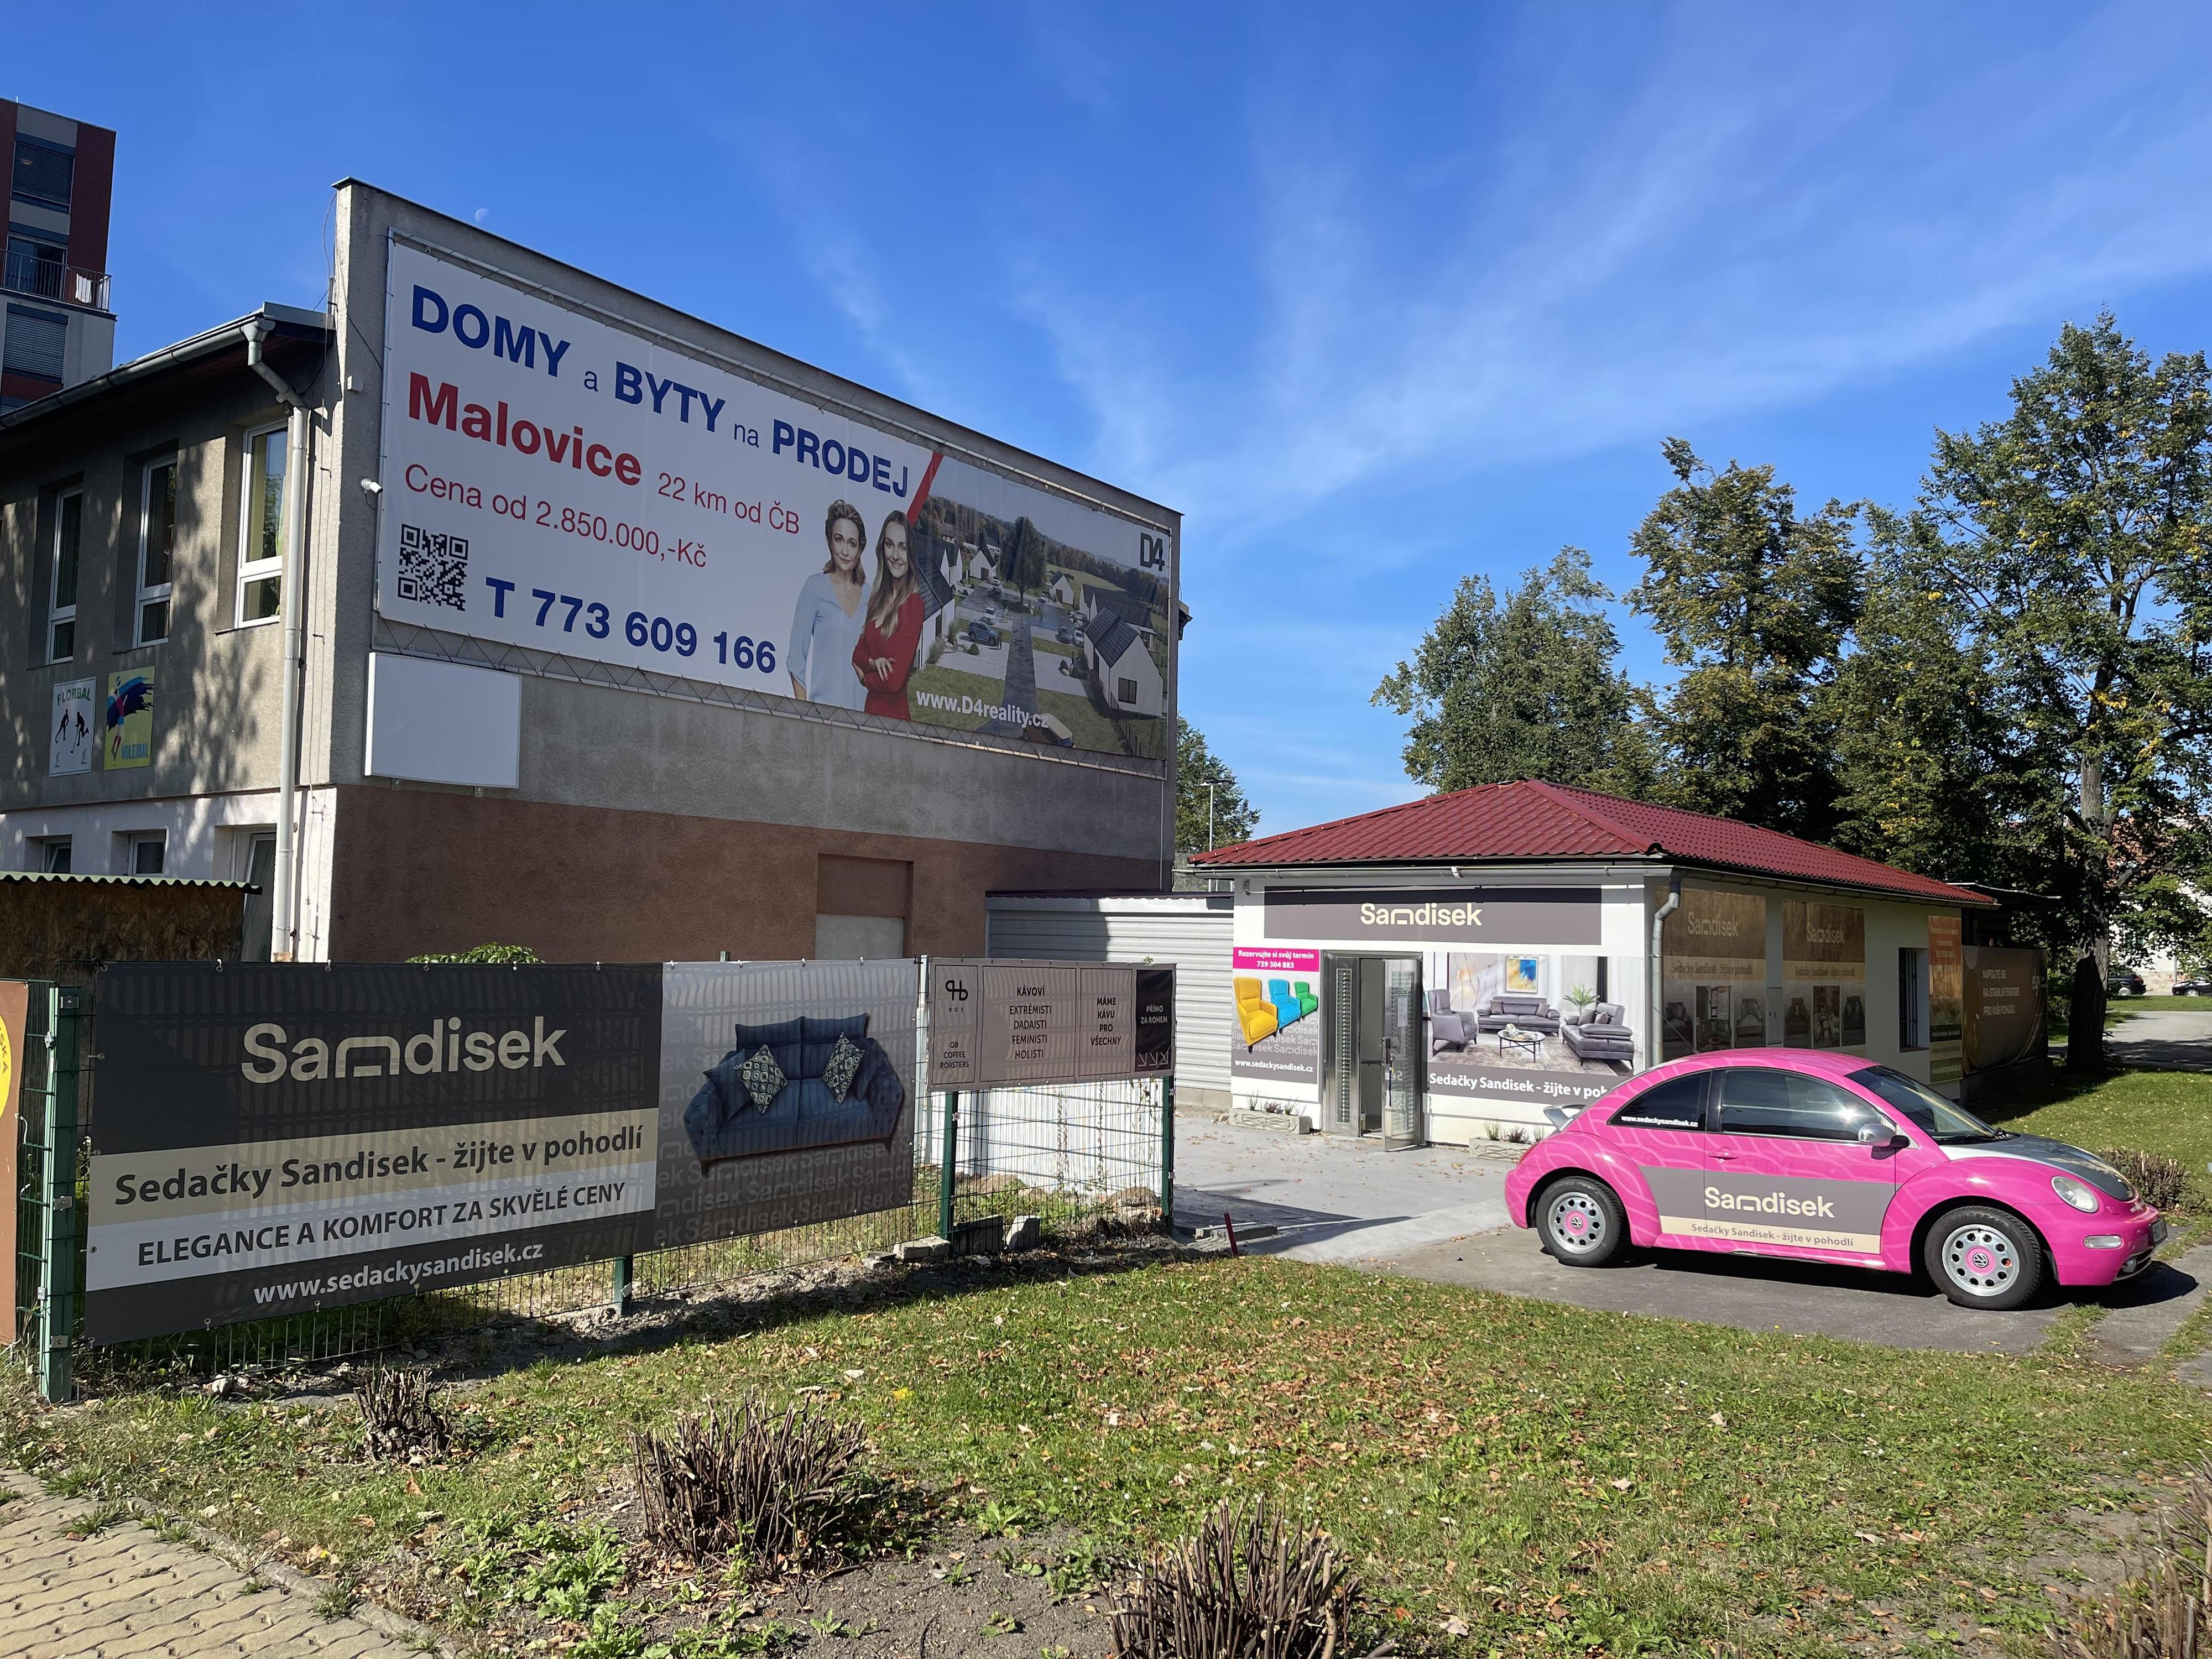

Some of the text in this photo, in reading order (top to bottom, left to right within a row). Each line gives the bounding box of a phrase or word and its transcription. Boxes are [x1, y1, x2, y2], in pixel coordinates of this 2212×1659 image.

[411, 284, 907, 497] DOMY a BYTY na PRODEJ
[408, 372, 799, 534] Malovice 22 km od ČB
[405, 464, 707, 567] Cena od 2.850.000,-Kč
[1139, 533, 1165, 572] D4
[485, 576, 775, 673] T 773 609 166
[58, 687, 90, 706] FLORBAL
[915, 690, 1048, 729] www.D4reality.cz
[122, 743, 148, 760] VOLEJBAL
[1360, 903, 1482, 926] Sandisek
[1688, 911, 1739, 937] Sandisek
[1807, 922, 1844, 944] Sandisek
[1238, 950, 1271, 959] Rezervujte
[1279, 951, 1292, 960] svůj
[1016, 985, 1045, 997] KÁVOVÍ
[1010, 1004, 1051, 1015] EXTRÉMISTI
[1097, 997, 1117, 1006] MÁME
[1146, 1004, 1164, 1013] PŘÍMO
[1098, 1010, 1115, 1019] KÁVU
[1149, 1015, 1168, 1024] ROHEM
[1014, 1020, 1047, 1030] DADAISTI
[1099, 1024, 1113, 1032] PRO
[241, 1016, 567, 1084] Sandisek
[1012, 1035, 1047, 1045] FEMINISTI
[1091, 1036, 1121, 1046] VŠECHNY
[1015, 1050, 1044, 1060] HOLISTI
[1235, 1060, 1313, 1072] www.sedackysandisek.cz
[1429, 1073, 1478, 1090] Sedačky
[1480, 1077, 1535, 1092] Sandisek
[1543, 1082, 1571, 1097] žijte
[1573, 1087, 1580, 1096] v
[1621, 1116, 1698, 1127] www.sedackysandisek.cz
[115, 1164, 272, 1206] Sedačky
[281, 1146, 428, 1188] Sandisek
[453, 1141, 514, 1173] žijte
[521, 1143, 536, 1162] v
[544, 1125, 643, 1165] pohodlí
[1704, 1187, 1835, 1218] Sandisek
[138, 1182, 625, 1266] ELEGANCE A KOMFORT ZA SKVĚLÉ CENY
[1692, 1224, 1729, 1236] Sedačky
[1732, 1228, 1774, 1239] Sandisek
[1782, 1232, 1803, 1243] žijte
[1814, 1237, 1853, 1246] pohodlí
[254, 1241, 543, 1305] www.sedackysandisek.cz
